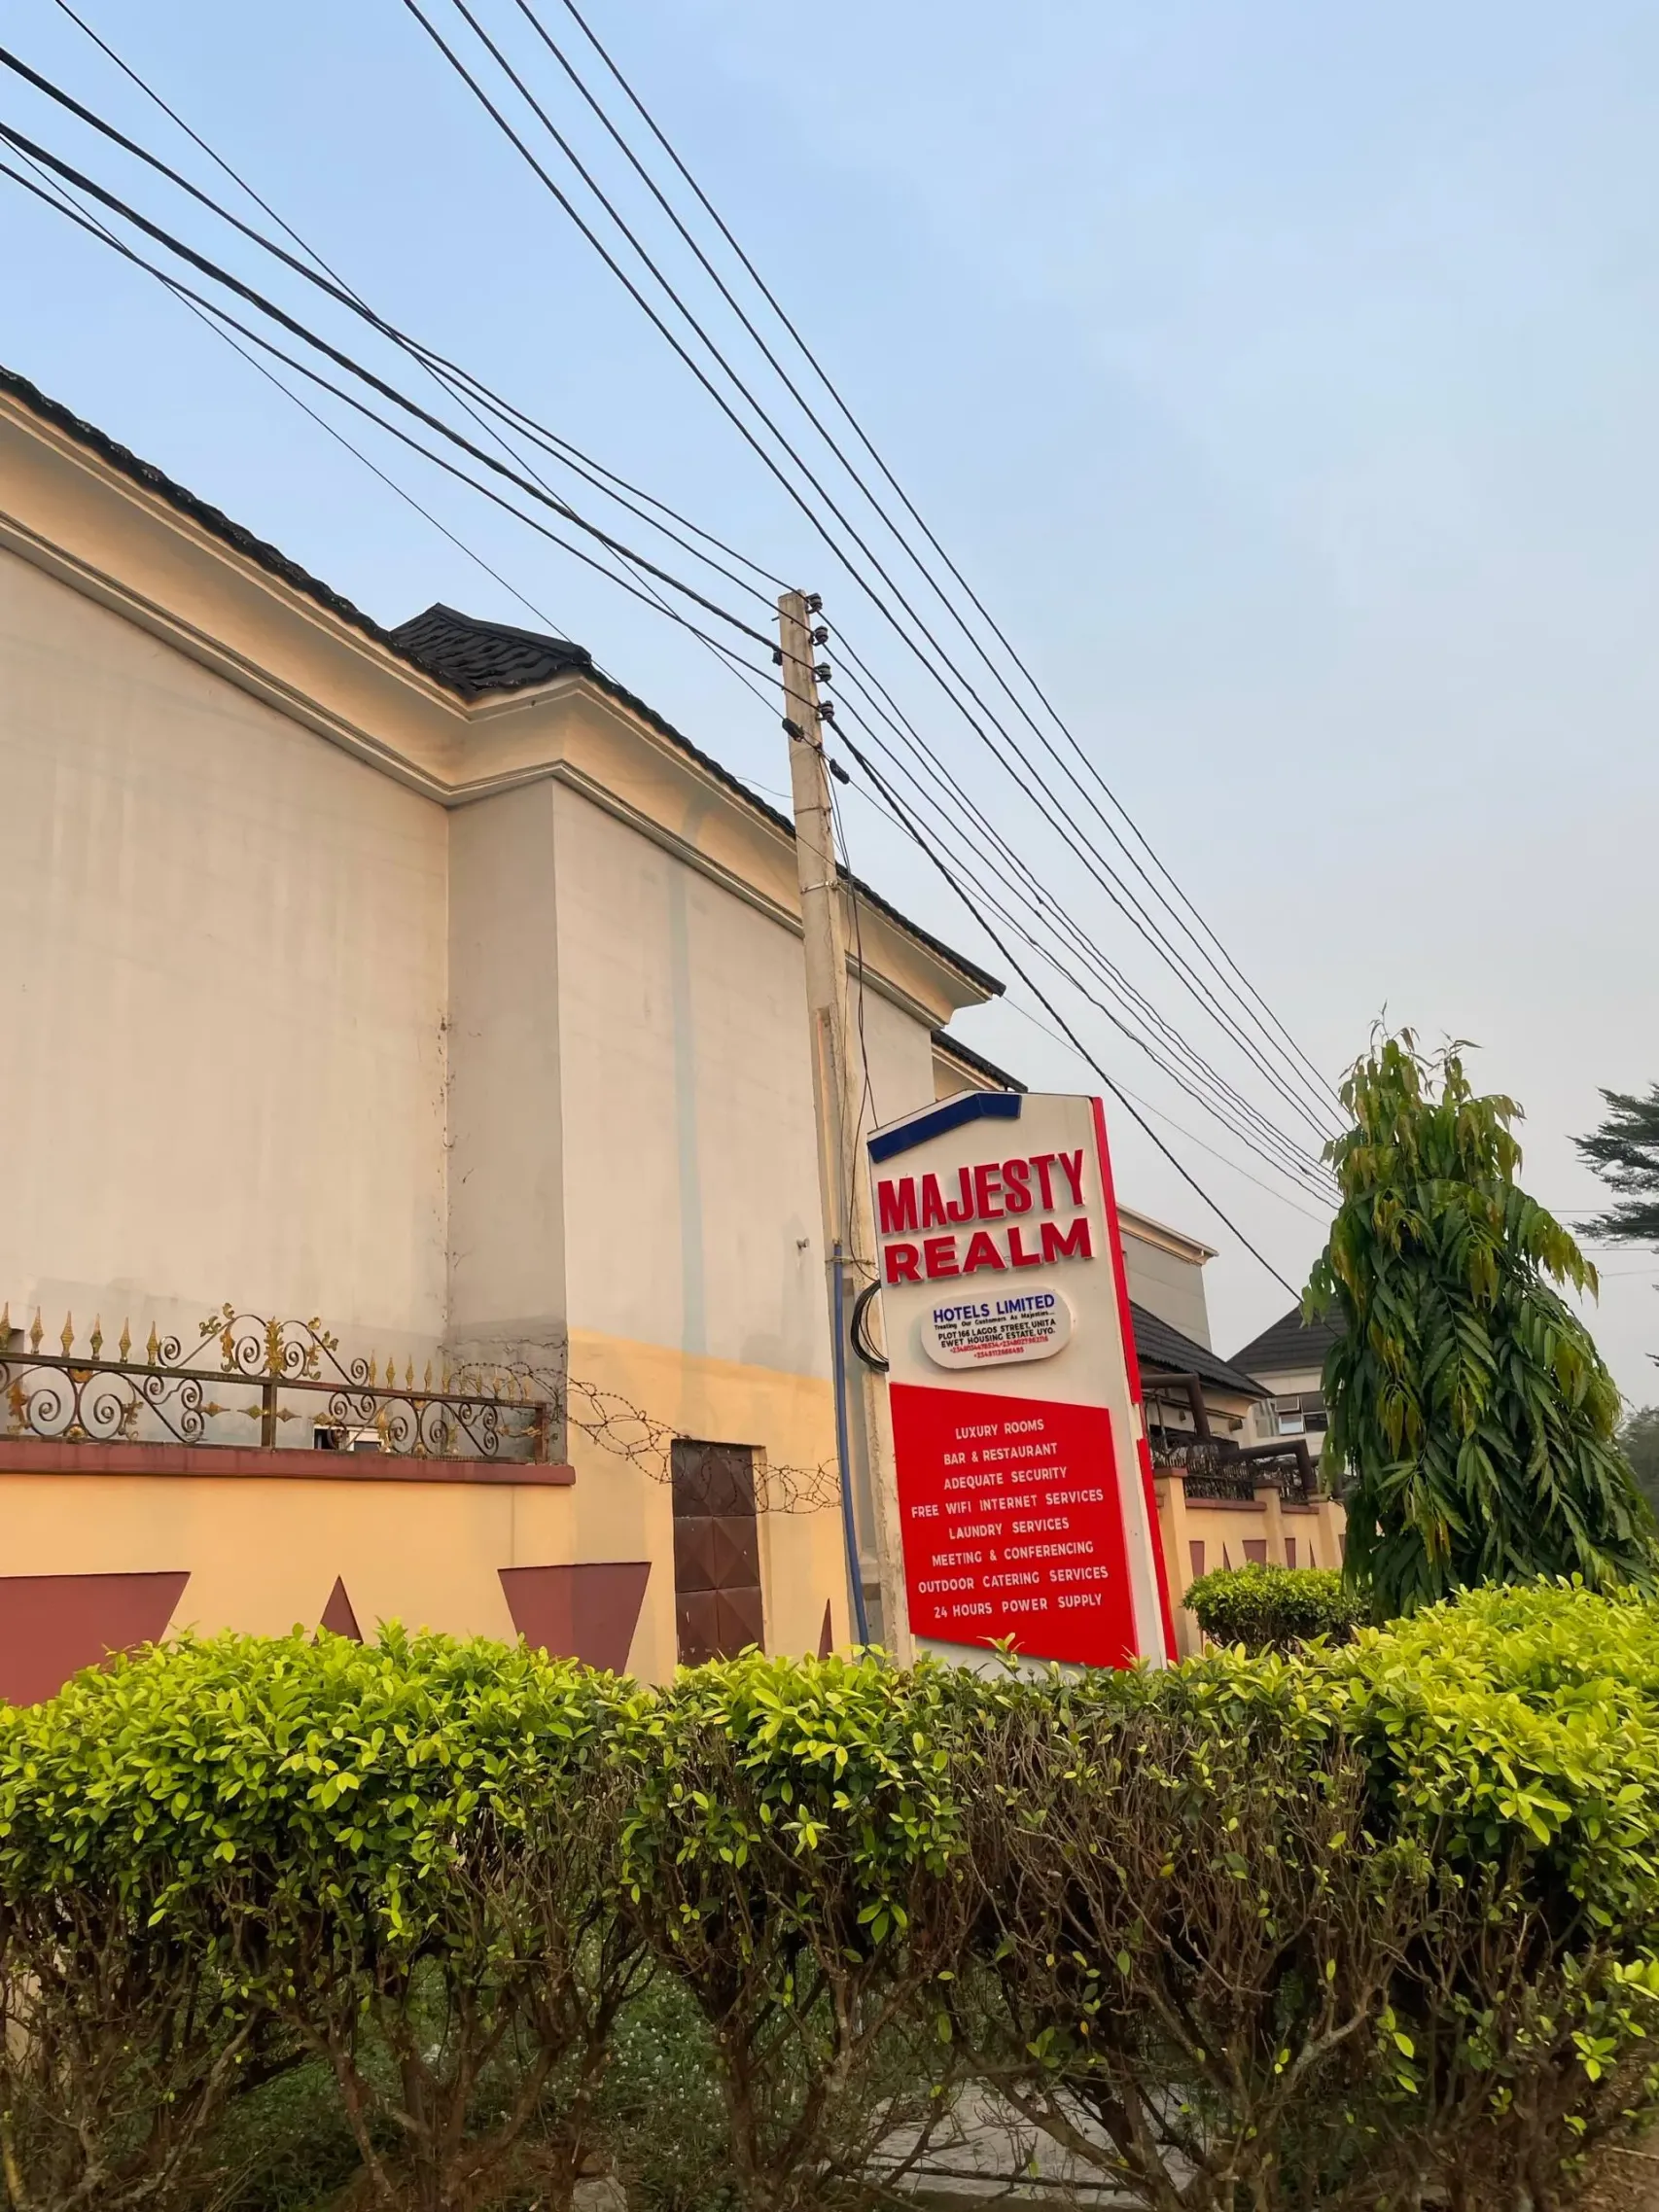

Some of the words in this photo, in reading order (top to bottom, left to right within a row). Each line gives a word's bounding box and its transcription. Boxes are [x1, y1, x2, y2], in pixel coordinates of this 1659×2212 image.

[878, 1148, 1085, 1235] MAJESTY
[884, 1217, 1094, 1285] REALM
[933, 1303, 990, 1323] HOTELS
[996, 1293, 1055, 1316] LIMITED
[937, 1331, 957, 1341] PLOT
[971, 1325, 998, 1336] LAGOS
[974, 1317, 1006, 1325] Customers
[940, 1338, 964, 1349] EWET
[968, 1333, 1004, 1344] HOUSING
[1037, 1327, 1056, 1336] UYO.
[955, 1423, 998, 1440] LUXURY
[1004, 1419, 1044, 1435] ROOMS
[943, 1452, 966, 1465] BAR
[971, 1451, 978, 1463] &
[982, 1442, 1058, 1462] RESTAURANT
[943, 1472, 1004, 1491] ADEQUATE
[1010, 1466, 1068, 1484] SECURITY
[911, 1505, 939, 1519] FREE
[945, 1500, 971, 1515] WIFI
[979, 1494, 1038, 1512] INTERNET
[1045, 1489, 1104, 1506] SERVICES
[948, 1523, 1003, 1540] LAUNDRY
[1011, 1517, 1070, 1534] SERVICES
[932, 1550, 982, 1567] MEETING
[989, 1549, 997, 1562] &
[1004, 1541, 1094, 1561] CONFERENCING
[918, 1576, 974, 1594] OUTDOOR
[982, 1571, 1041, 1589] CATERING
[1049, 1565, 1109, 1583] SERVICES
[934, 1606, 948, 1619] 24
[953, 1602, 993, 1618] HOURS
[1002, 1598, 1048, 1614] POWER
[1057, 1593, 1103, 1609] SUPPLY
